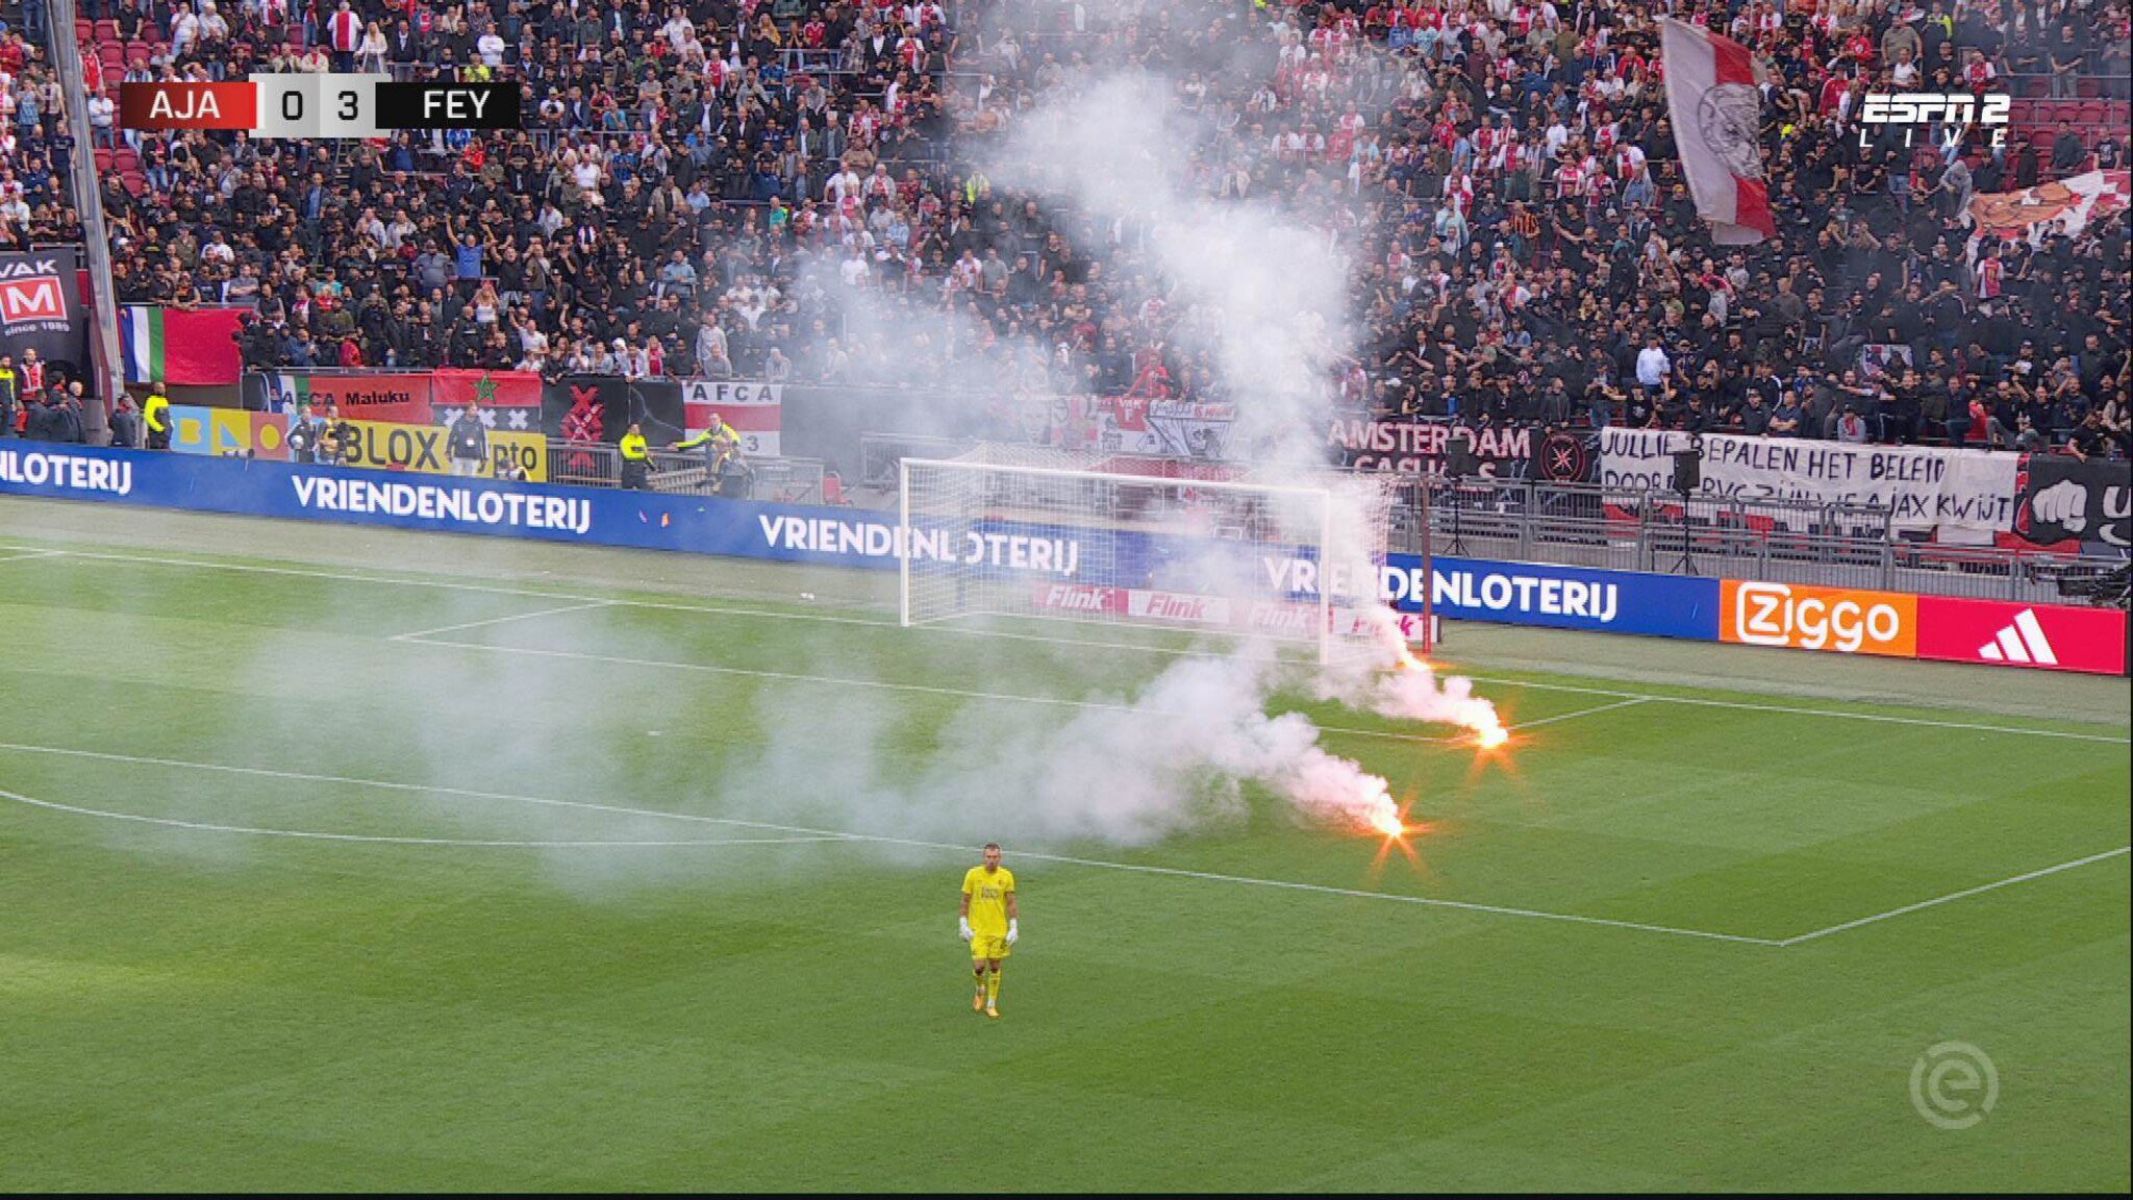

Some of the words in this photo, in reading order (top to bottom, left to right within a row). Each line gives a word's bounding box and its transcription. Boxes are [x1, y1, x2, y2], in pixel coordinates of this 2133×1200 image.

[6, 283, 56, 315] M
[282, 391, 336, 405] AFCA
[345, 391, 410, 405] Maluku
[692, 384, 774, 401] AFCA
[347, 426, 440, 469] BLOX
[1327, 420, 1531, 459] AMSTERDAM
[1601, 432, 1677, 460] JULLIE
[1690, 437, 1798, 472] BEPALEN
[1808, 450, 1857, 480] HET
[1870, 453, 1945, 483] BELEID
[292, 475, 590, 534] VRIENDENLOTERIJ
[1936, 494, 2012, 522] KWIJT
[1047, 583, 1107, 611] Flink
[1146, 594, 1207, 619] Flink
